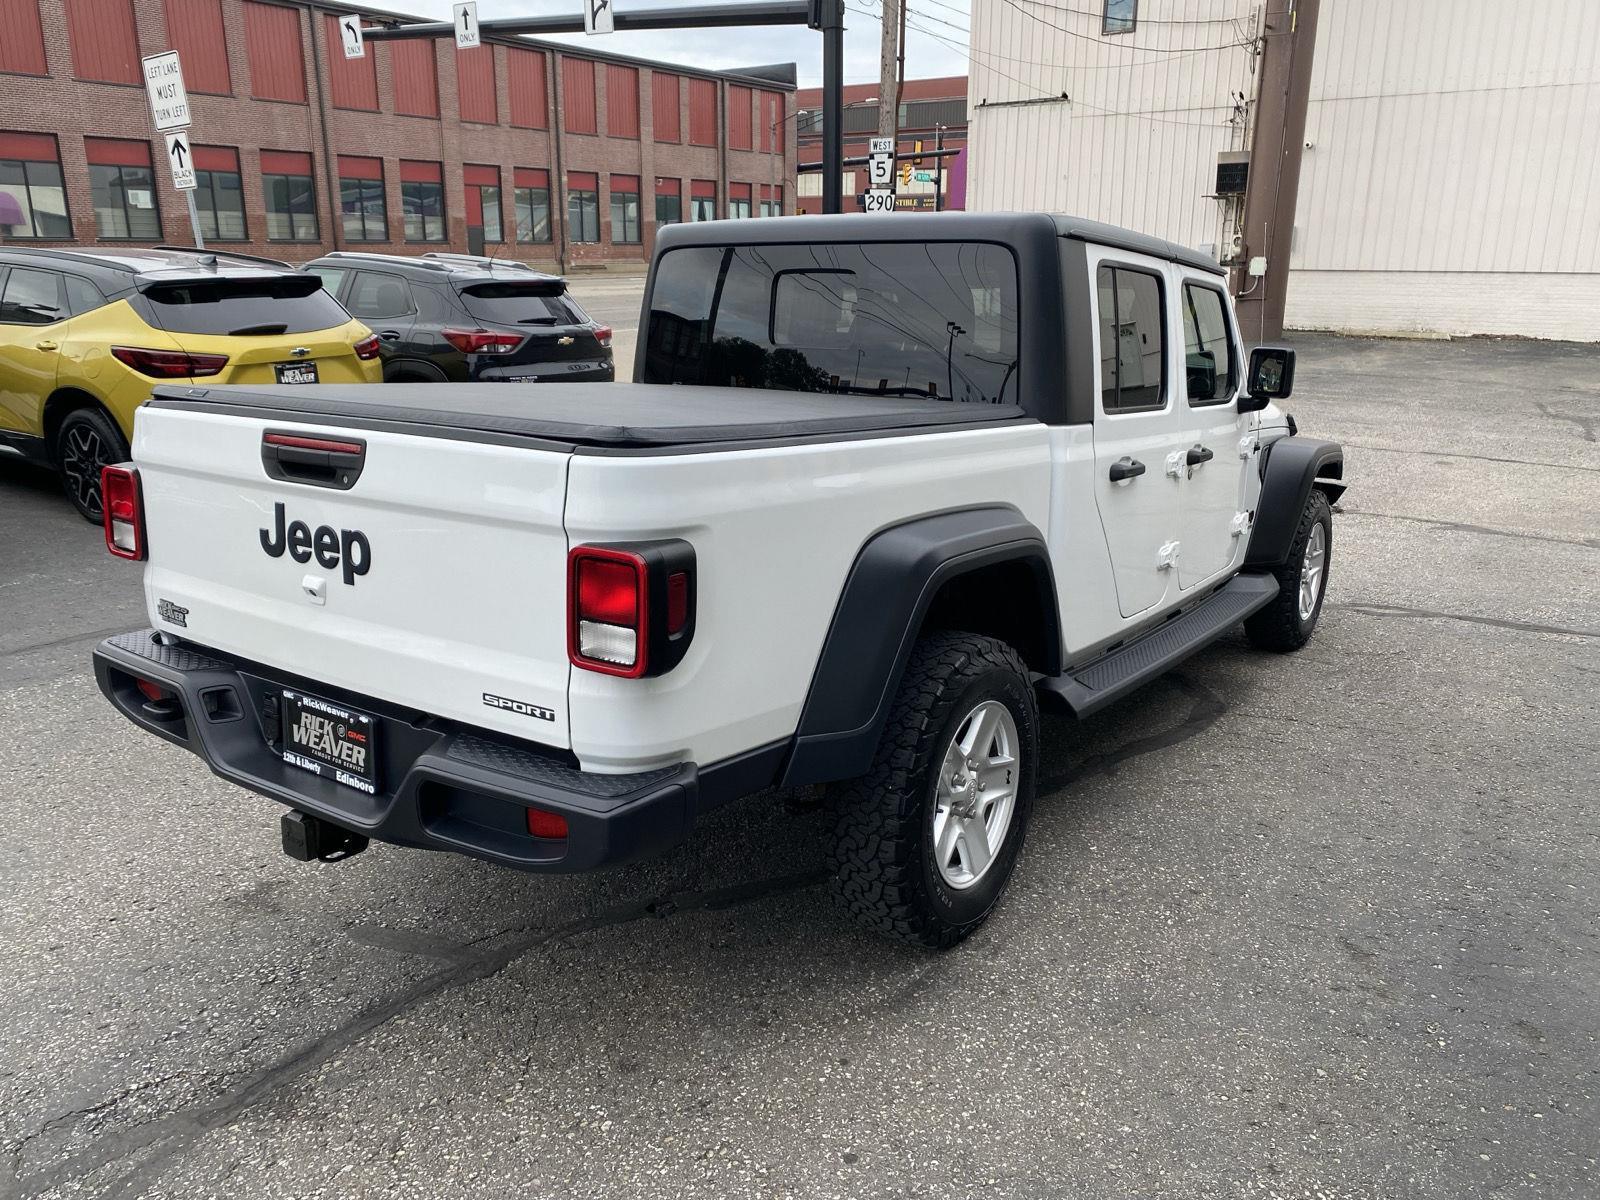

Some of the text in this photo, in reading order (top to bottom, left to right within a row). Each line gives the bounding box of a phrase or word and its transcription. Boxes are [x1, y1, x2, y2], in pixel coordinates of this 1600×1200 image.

[460, 33, 476, 43] ONLY
[347, 46, 361, 55] ONLY
[147, 62, 178, 79] LEFT LANE
[156, 83, 177, 100] MUST
[155, 105, 186, 121] TURN LEFT
[872, 141, 891, 151] WEST
[174, 169, 192, 180] BLACK
[876, 161, 886, 177] 5
[867, 194, 893, 211] 290
[895, 198, 918, 207] STIBLE
[281, 373, 315, 384] WEAVER
[259, 501, 371, 586] Jeep
[302, 697, 349, 719] RickWeaver
[483, 694, 555, 720] SPORT
[300, 711, 334, 736] RICK
[347, 730, 366, 742] GMC
[292, 723, 366, 767] WEAVER
[283, 752, 321, 775] 12th & Liberty
[311, 749, 365, 774] FAMOUS FOR SERVICE
[335, 770, 375, 794] Edinboro
